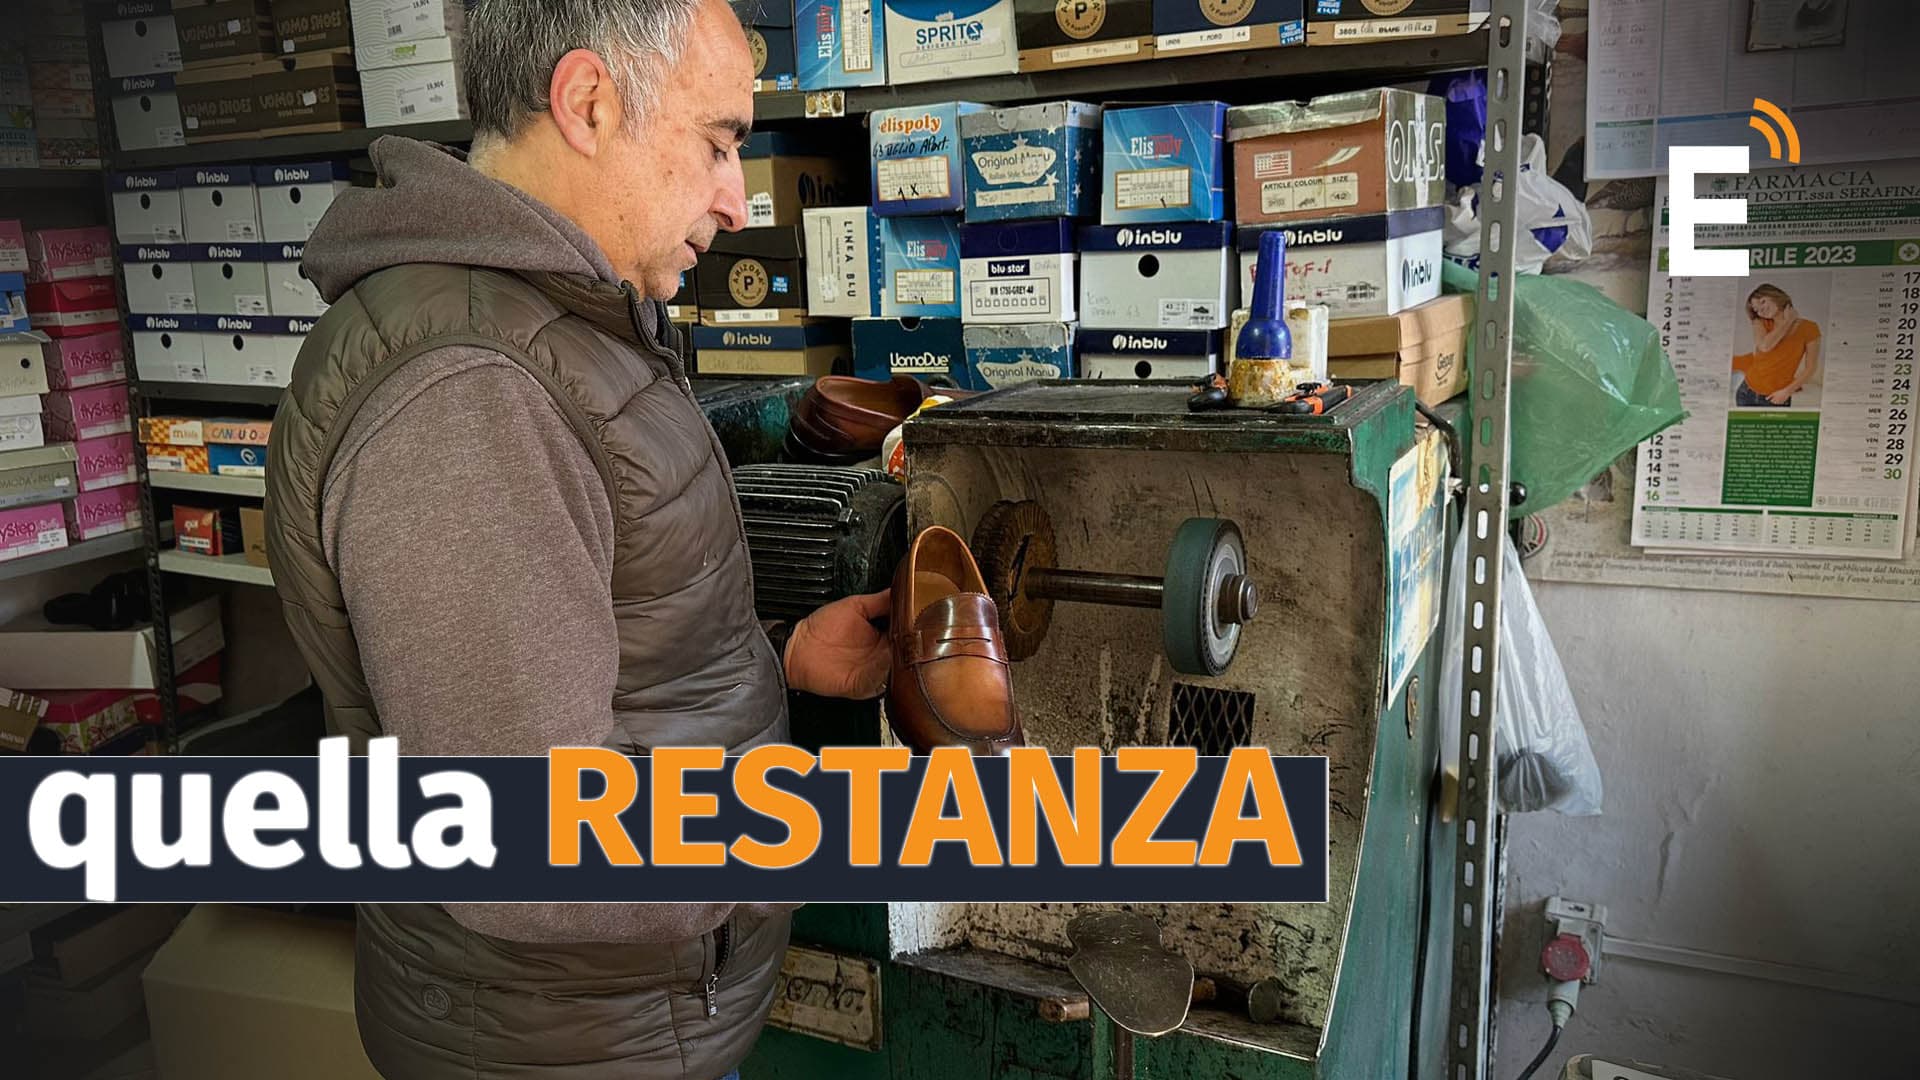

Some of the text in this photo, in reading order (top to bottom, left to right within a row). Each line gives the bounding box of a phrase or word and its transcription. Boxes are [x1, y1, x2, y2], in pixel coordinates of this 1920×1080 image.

[977, 153, 1018, 169] Original
[205, 171, 230, 184] inblu
[283, 168, 310, 181] inblu
[1735, 170, 1875, 192] FARMACIA
[133, 176, 158, 189] inblu
[1294, 178, 1323, 188] COLOUR
[1331, 175, 1349, 184] SIZE
[1134, 229, 1183, 246] inblu
[1297, 229, 1343, 246] inblu
[147, 248, 171, 260] inblu
[218, 246, 242, 259] inblu
[843, 220, 857, 298] LINEA BLU
[1804, 245, 1856, 265] 2023
[990, 262, 1006, 275] blu
[1007, 262, 1027, 275] star
[1410, 257, 1433, 288] inblu
[744, 275, 754, 291] P
[1666, 277, 1673, 289] 1
[1903, 271, 1920, 284] 17
[1664, 292, 1673, 304] 2
[1902, 286, 1920, 299] 18
[1663, 306, 1672, 319] 3
[1900, 302, 1919, 314] 19
[155, 317, 180, 330] inblu
[226, 318, 252, 331] inblu
[1662, 321, 1671, 333] 4
[1897, 317, 1917, 330] 20
[737, 332, 772, 346] inblu
[1127, 335, 1168, 350] inblu
[1662, 335, 1670, 347] 5
[1896, 333, 1914, 346] 21
[889, 351, 949, 367] UomoDue
[1894, 348, 1914, 361] 22
[982, 366, 1024, 381] Original
[1893, 363, 1912, 376] 23
[1892, 378, 1911, 391] 24
[1890, 393, 1909, 406] 25
[1888, 408, 1908, 421] 26
[1887, 423, 1906, 436] 27
[1649, 434, 1664, 447] 12
[1885, 438, 1905, 450] 28
[1647, 448, 1662, 461] 13
[1884, 453, 1904, 465] 29
[83, 454, 125, 474] flyStep
[1647, 462, 1662, 474] 14
[1882, 468, 1902, 480] 30
[1646, 476, 1661, 488] 15
[1645, 490, 1661, 502] 16
[83, 502, 124, 522] flyStep
[0, 519, 37, 543] yStep
[1874, 564, 1887, 574] dal
